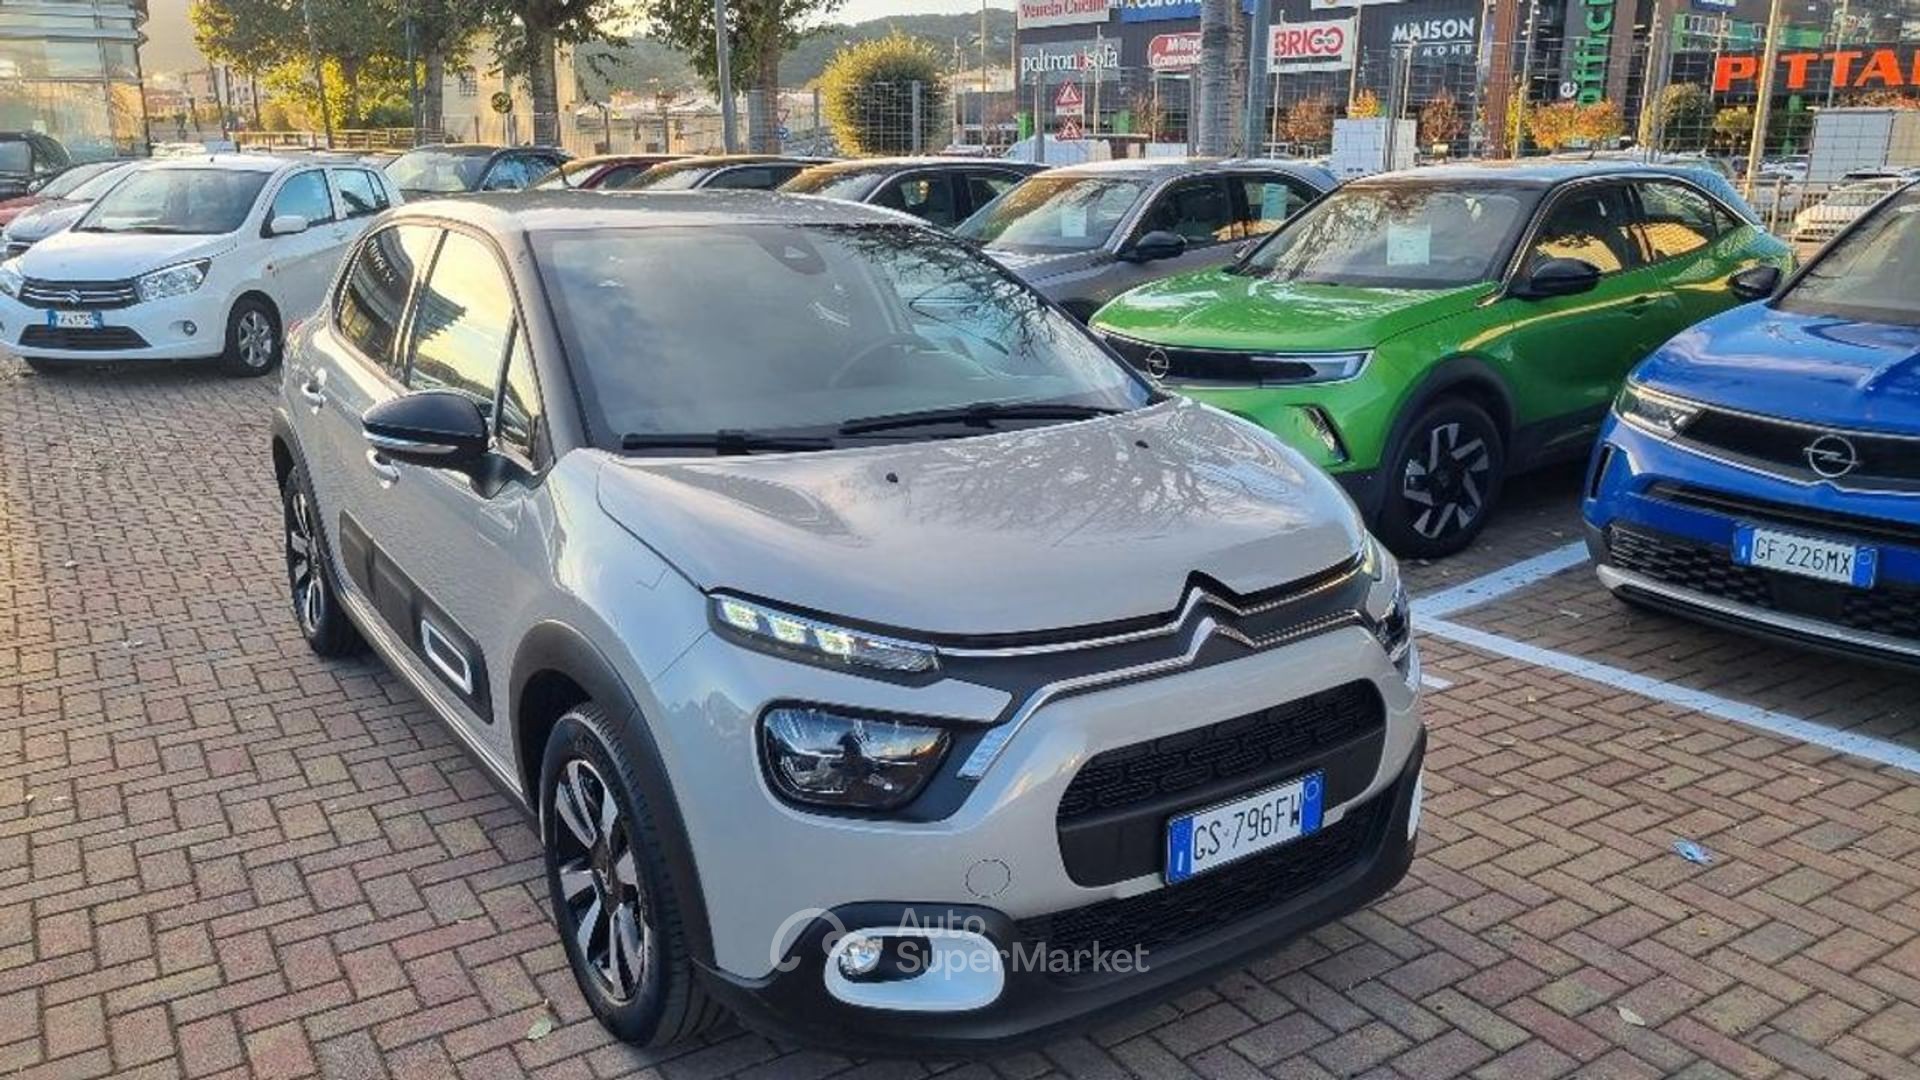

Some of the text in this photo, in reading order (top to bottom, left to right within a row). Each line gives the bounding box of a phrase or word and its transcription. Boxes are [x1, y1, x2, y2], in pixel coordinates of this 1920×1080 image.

[1274, 27, 1344, 56] BRICO
[1391, 17, 1475, 43] MAISON
[1785, 543, 1852, 576] 226MX
[1193, 820, 1221, 860] GS
[1232, 792, 1302, 849] 796FW
